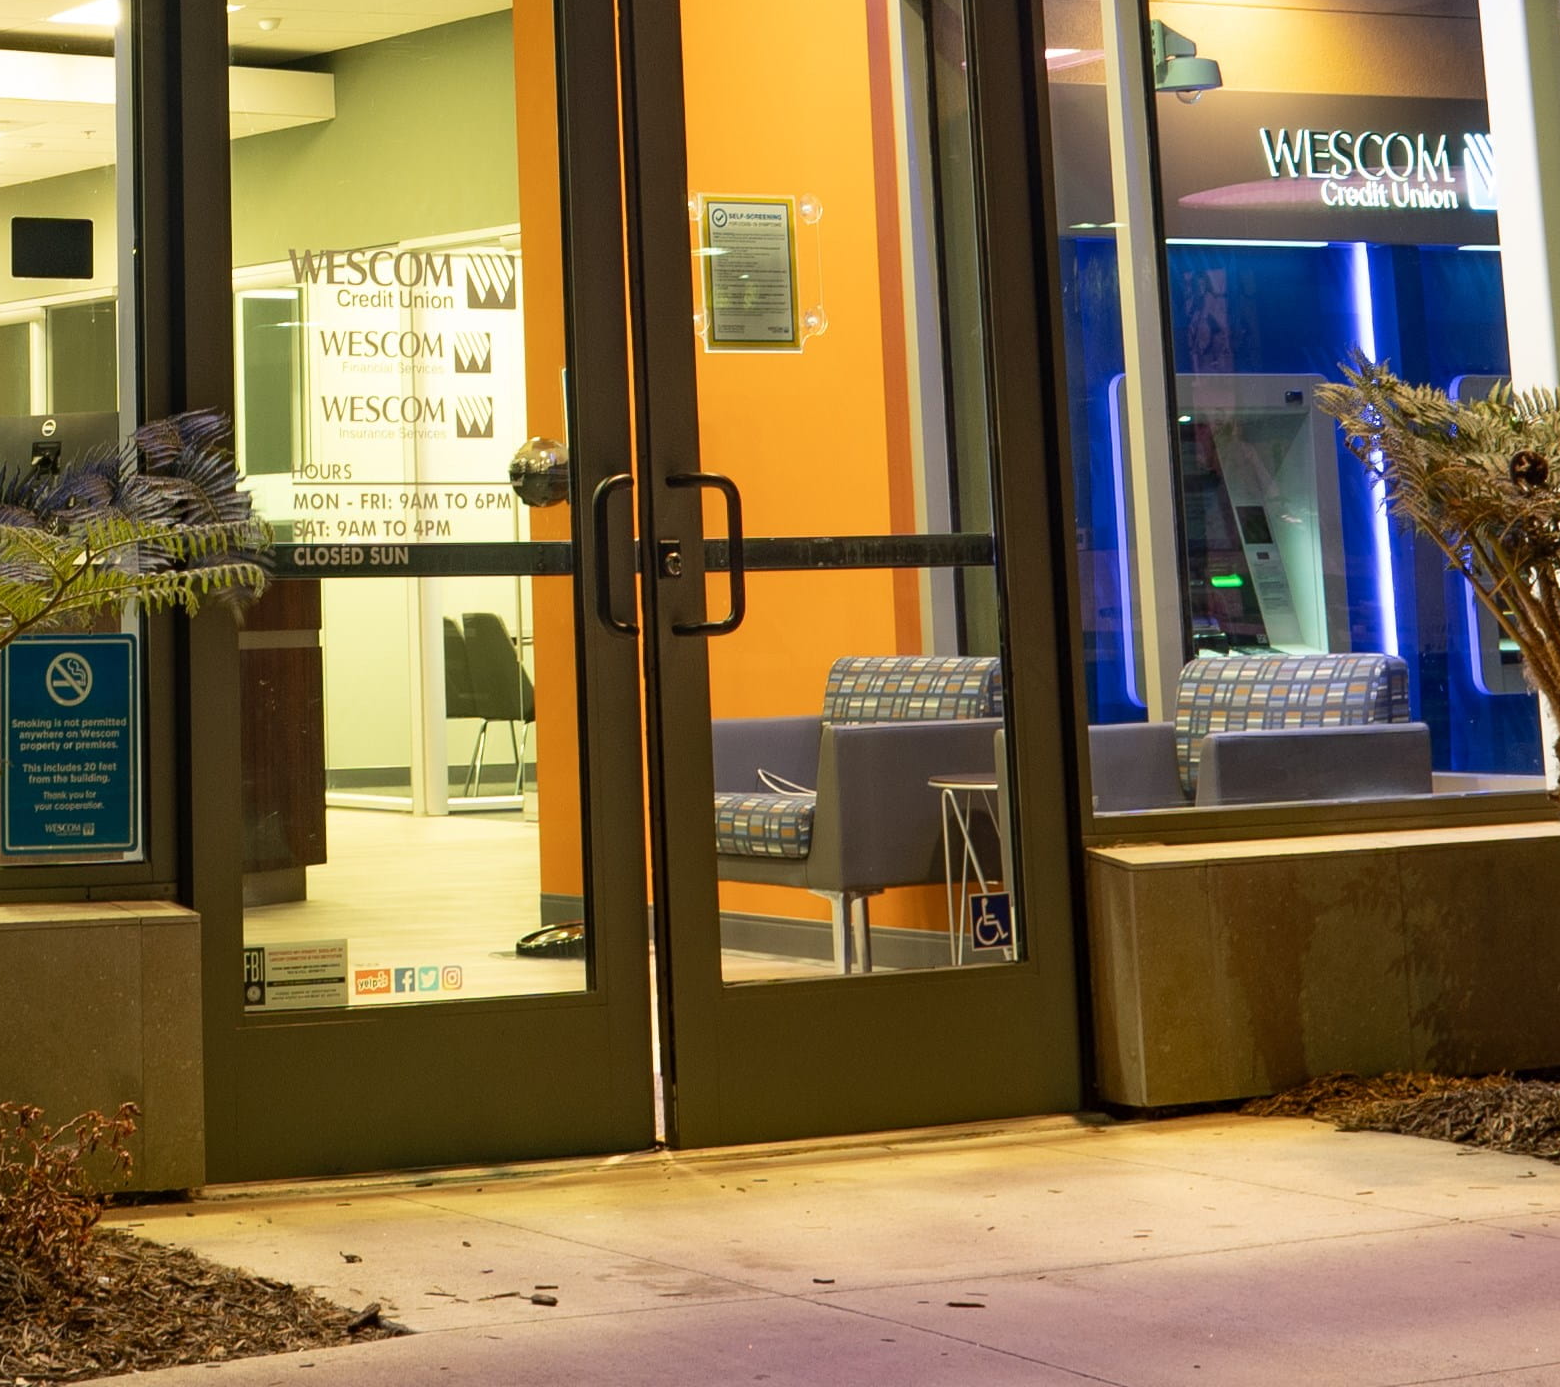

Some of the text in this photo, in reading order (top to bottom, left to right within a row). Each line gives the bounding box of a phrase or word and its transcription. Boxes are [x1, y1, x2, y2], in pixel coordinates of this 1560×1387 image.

[1259, 127, 1456, 183] WESCOM
[1320, 180, 1459, 209] Credit Union
[288, 248, 453, 287] WESCOM
[337, 289, 454, 309] Credit Union
[319, 330, 444, 358] WESCOM
[342, 361, 445, 374] Financial Services
[321, 396, 445, 423] WESCOM
[339, 428, 447, 440] Insurance Services
[291, 463, 352, 479] HOURS
[293, 493, 339, 510] MON
[360, 493, 392, 509] FRI:
[399, 493, 439, 509] 9AM
[444, 493, 468, 509] TO
[475, 492, 511, 509] 6PM
[293, 520, 451, 537] SAT: 9AM TO 4PM
[293, 547, 409, 565] CLOSED SUN
[11, 717, 128, 729] Smoking is not permitted
[19, 729, 64, 741] anywhere
[80, 729, 120, 738] Wescom
[20, 740, 119, 752] property or premises.
[22, 761, 118, 773] This includes 20 feet
[28, 773, 111, 785] from the building.
[43, 790, 97, 801] Thank you for
[34, 801, 105, 814] your cooperation.
[44, 823, 82, 833] WESCOM
[243, 950, 264, 983] FBI
[358, 978, 379, 990] yelp
